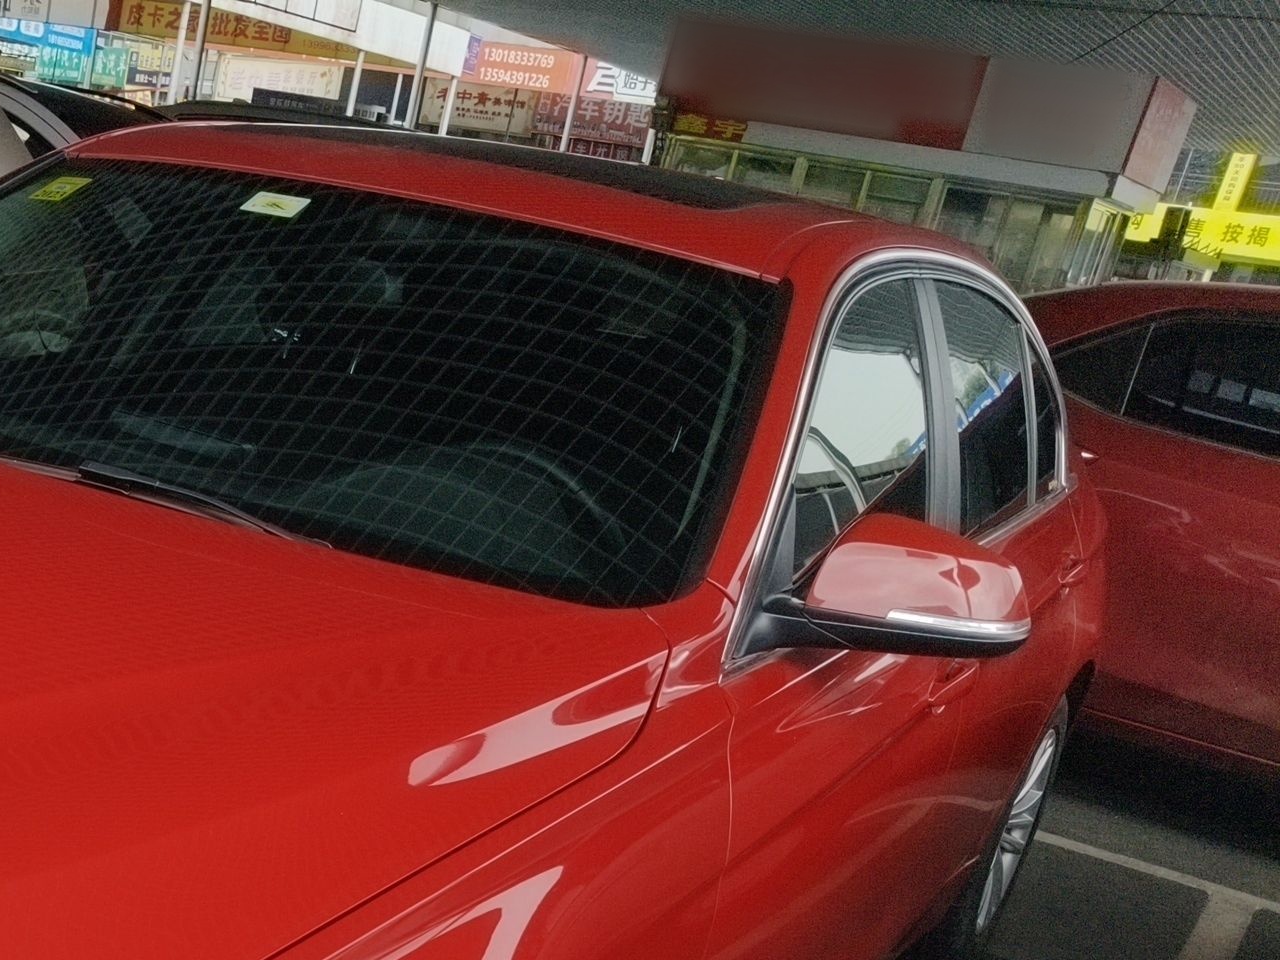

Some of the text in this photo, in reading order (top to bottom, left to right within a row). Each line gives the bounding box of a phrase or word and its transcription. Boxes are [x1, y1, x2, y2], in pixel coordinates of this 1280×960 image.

[483, 47, 555, 69] 13018333769
[479, 67, 550, 89] 13594391226
[1220, 222, 1272, 247] 按揭
